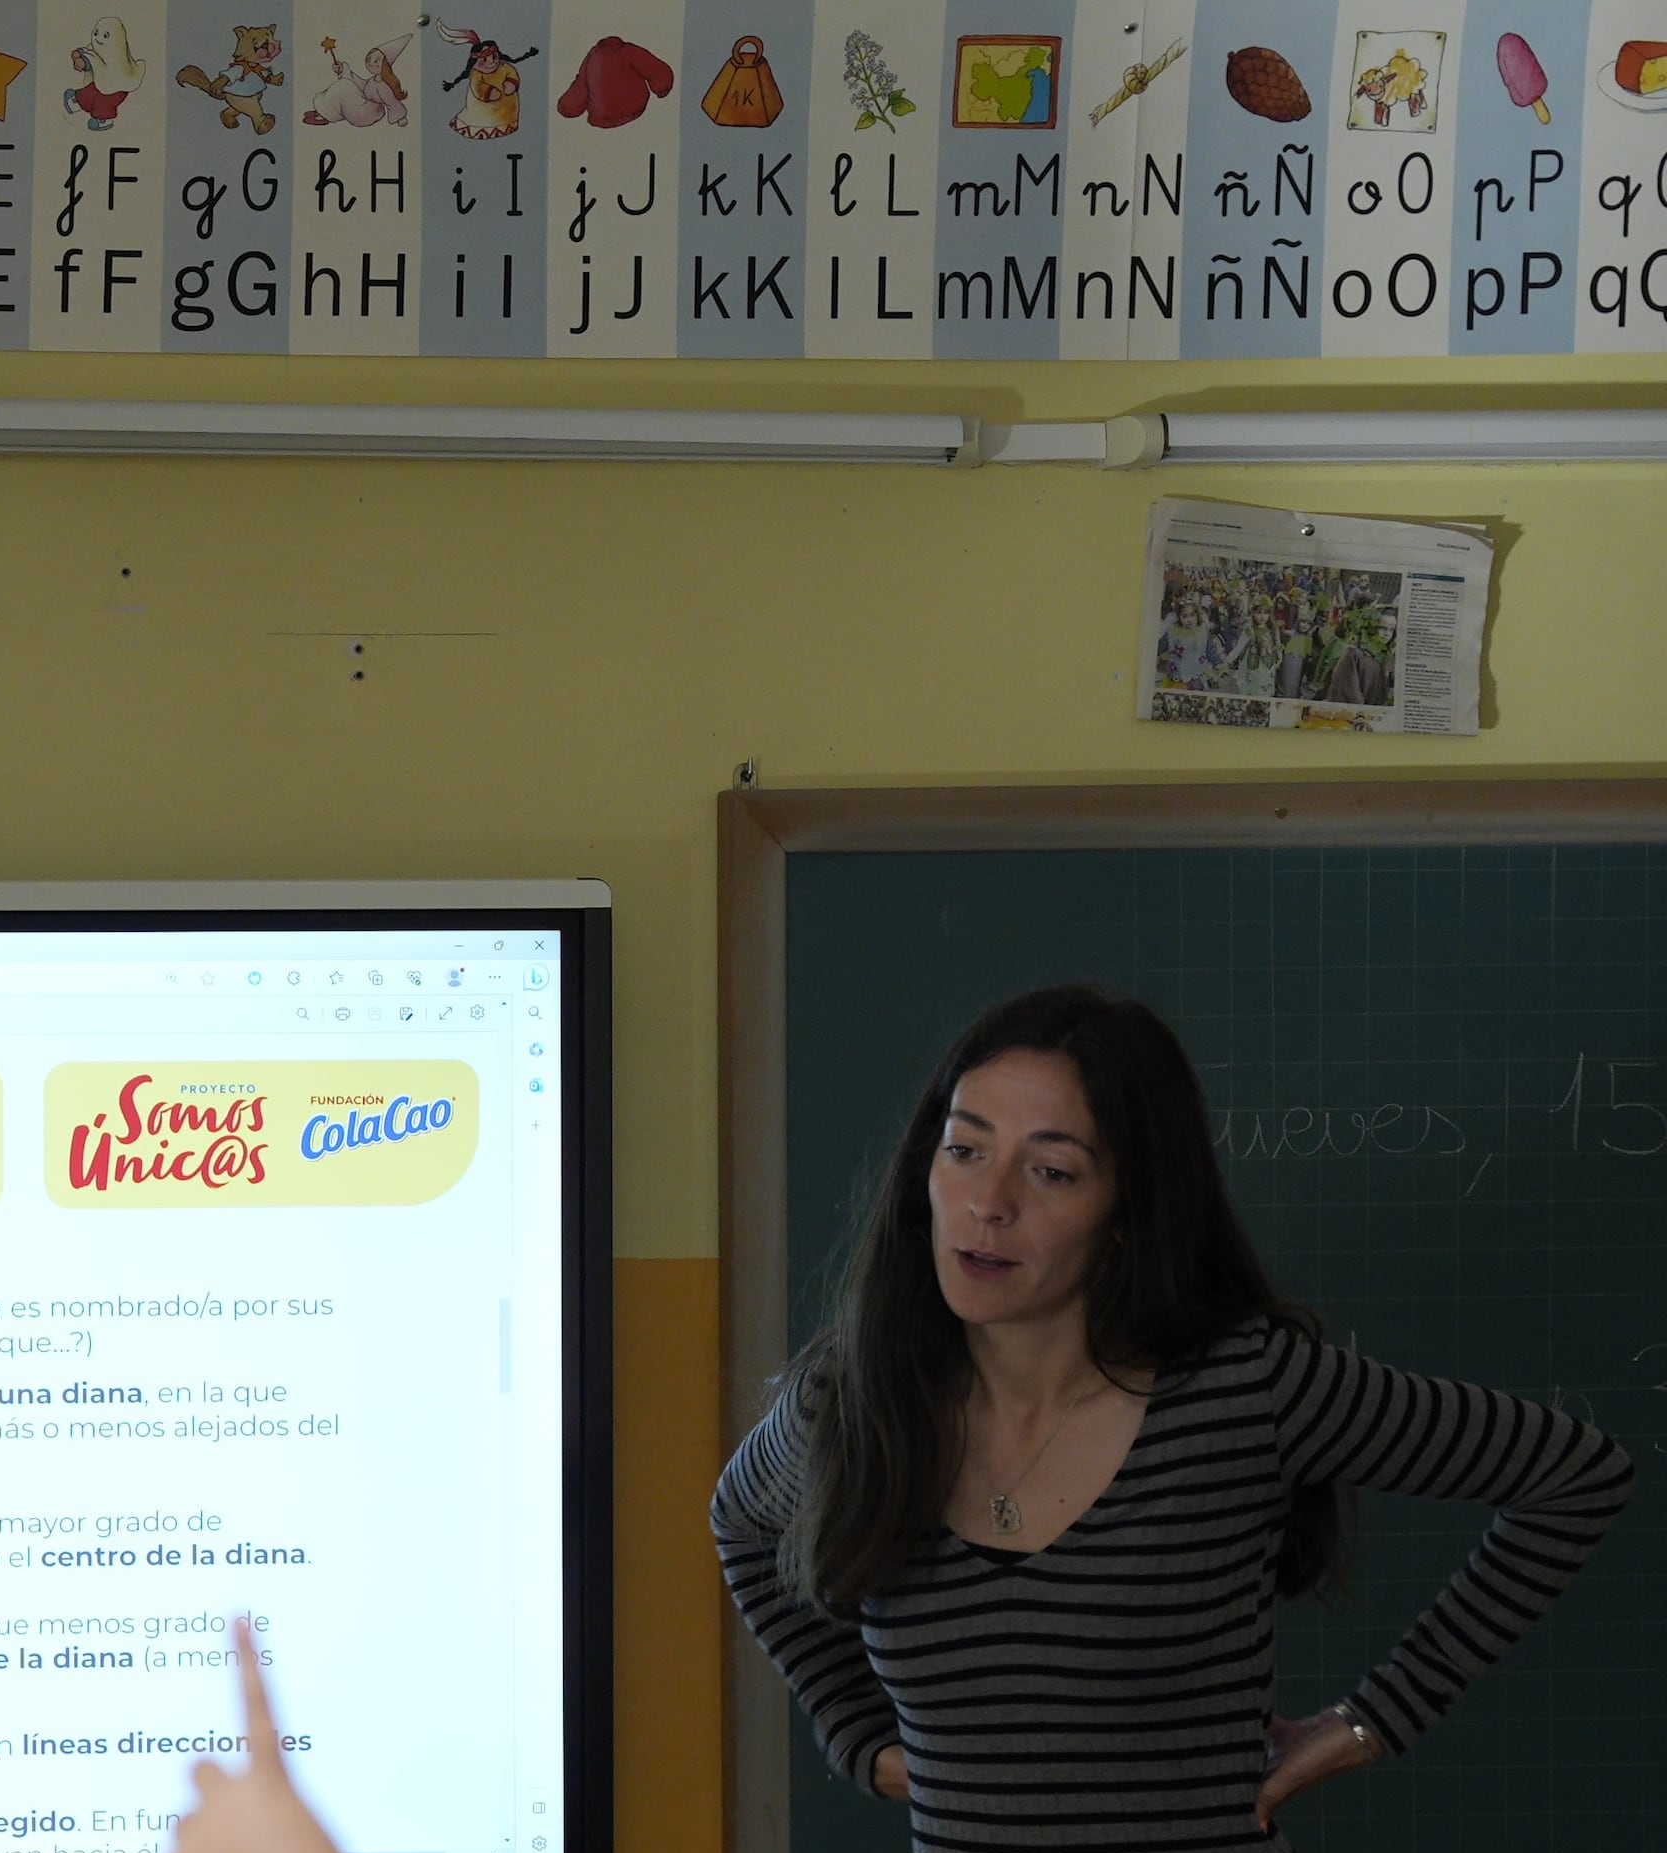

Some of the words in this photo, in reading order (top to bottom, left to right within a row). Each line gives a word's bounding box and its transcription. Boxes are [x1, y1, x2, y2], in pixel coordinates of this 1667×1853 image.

[180, 1084, 258, 1094] PROYECTO
[309, 1093, 385, 1107] FUNDACIÓN
[115, 1074, 269, 1146] Somos
[1194, 1063, 1493, 1197] ueves,
[1548, 1052, 1667, 1155] 15
[299, 1095, 455, 1162] ColaCao
[10, 1301, 42, 1319] es
[233, 1299, 280, 1323] por
[287, 1298, 334, 1316] sus
[95, 1509, 180, 1539] grado
[186, 1508, 223, 1532] de
[38, 1617, 136, 1636] menos
[143, 1609, 226, 1640] grado
[22, 1732, 110, 1756] líneas
